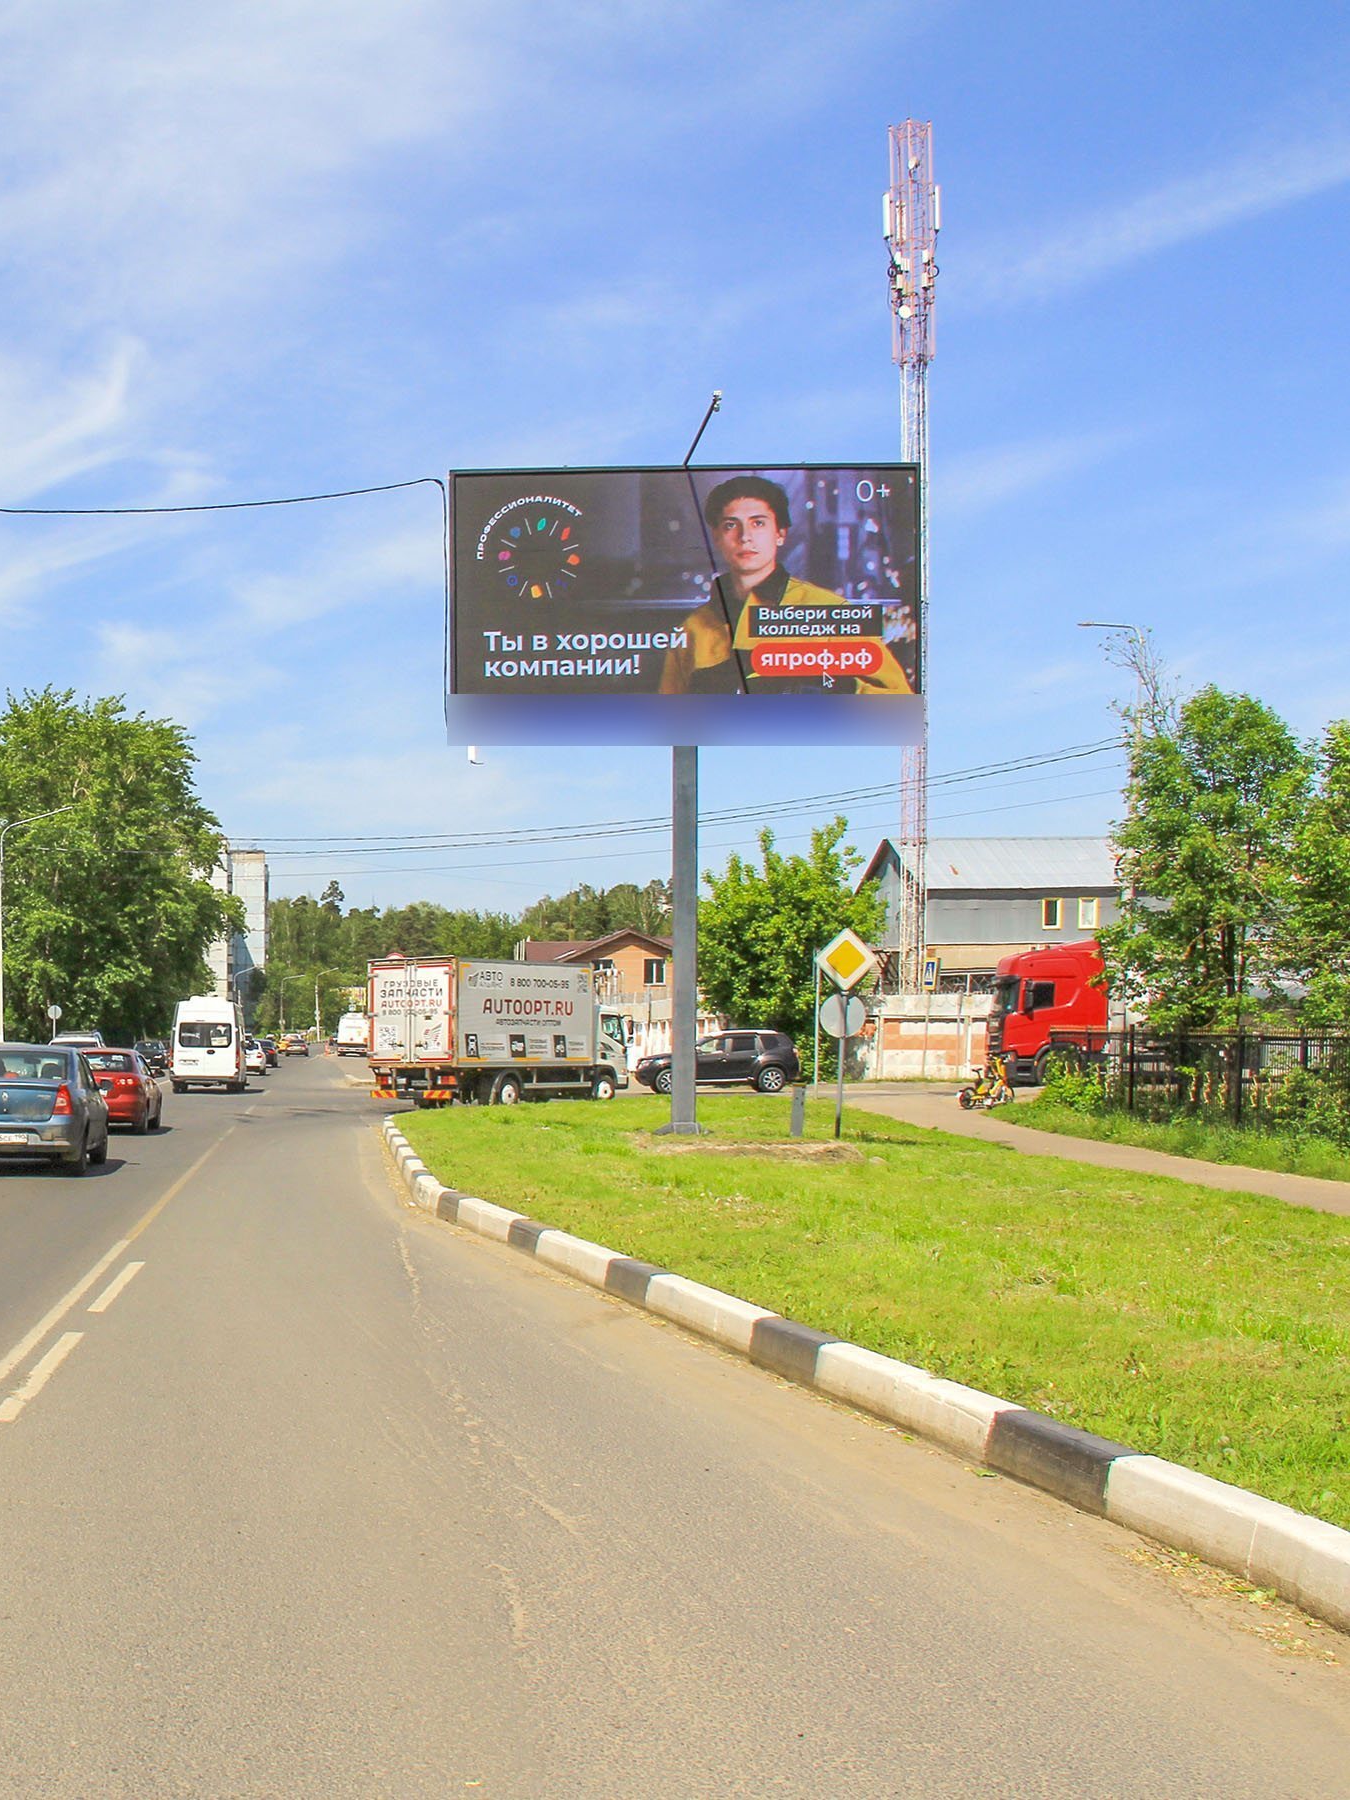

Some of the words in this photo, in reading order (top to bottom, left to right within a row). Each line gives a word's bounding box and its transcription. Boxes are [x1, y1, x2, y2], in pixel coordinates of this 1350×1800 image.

[856, 479, 891, 502] 0+
[476, 495, 584, 561] ПРОФЕССИОНАЛИТЕТ
[758, 606, 827, 622] Выбери
[831, 605, 873, 619] свой
[758, 623, 836, 637] колледж
[840, 623, 861, 635] на
[483, 630, 523, 651] Ты
[532, 633, 548, 651] в
[556, 626, 688, 655] хорошей
[484, 654, 641, 677] компании!
[761, 648, 873, 671] япроф.рф
[383, 979, 439, 988] ГРУЗОВЫЕ
[479, 970, 504, 982] АВТО
[510, 977, 515, 987] 8
[517, 977, 531, 988] 800
[380, 988, 443, 998] ЗАПЧАСТИ
[483, 998, 574, 1016] AUTOOPT.RU
